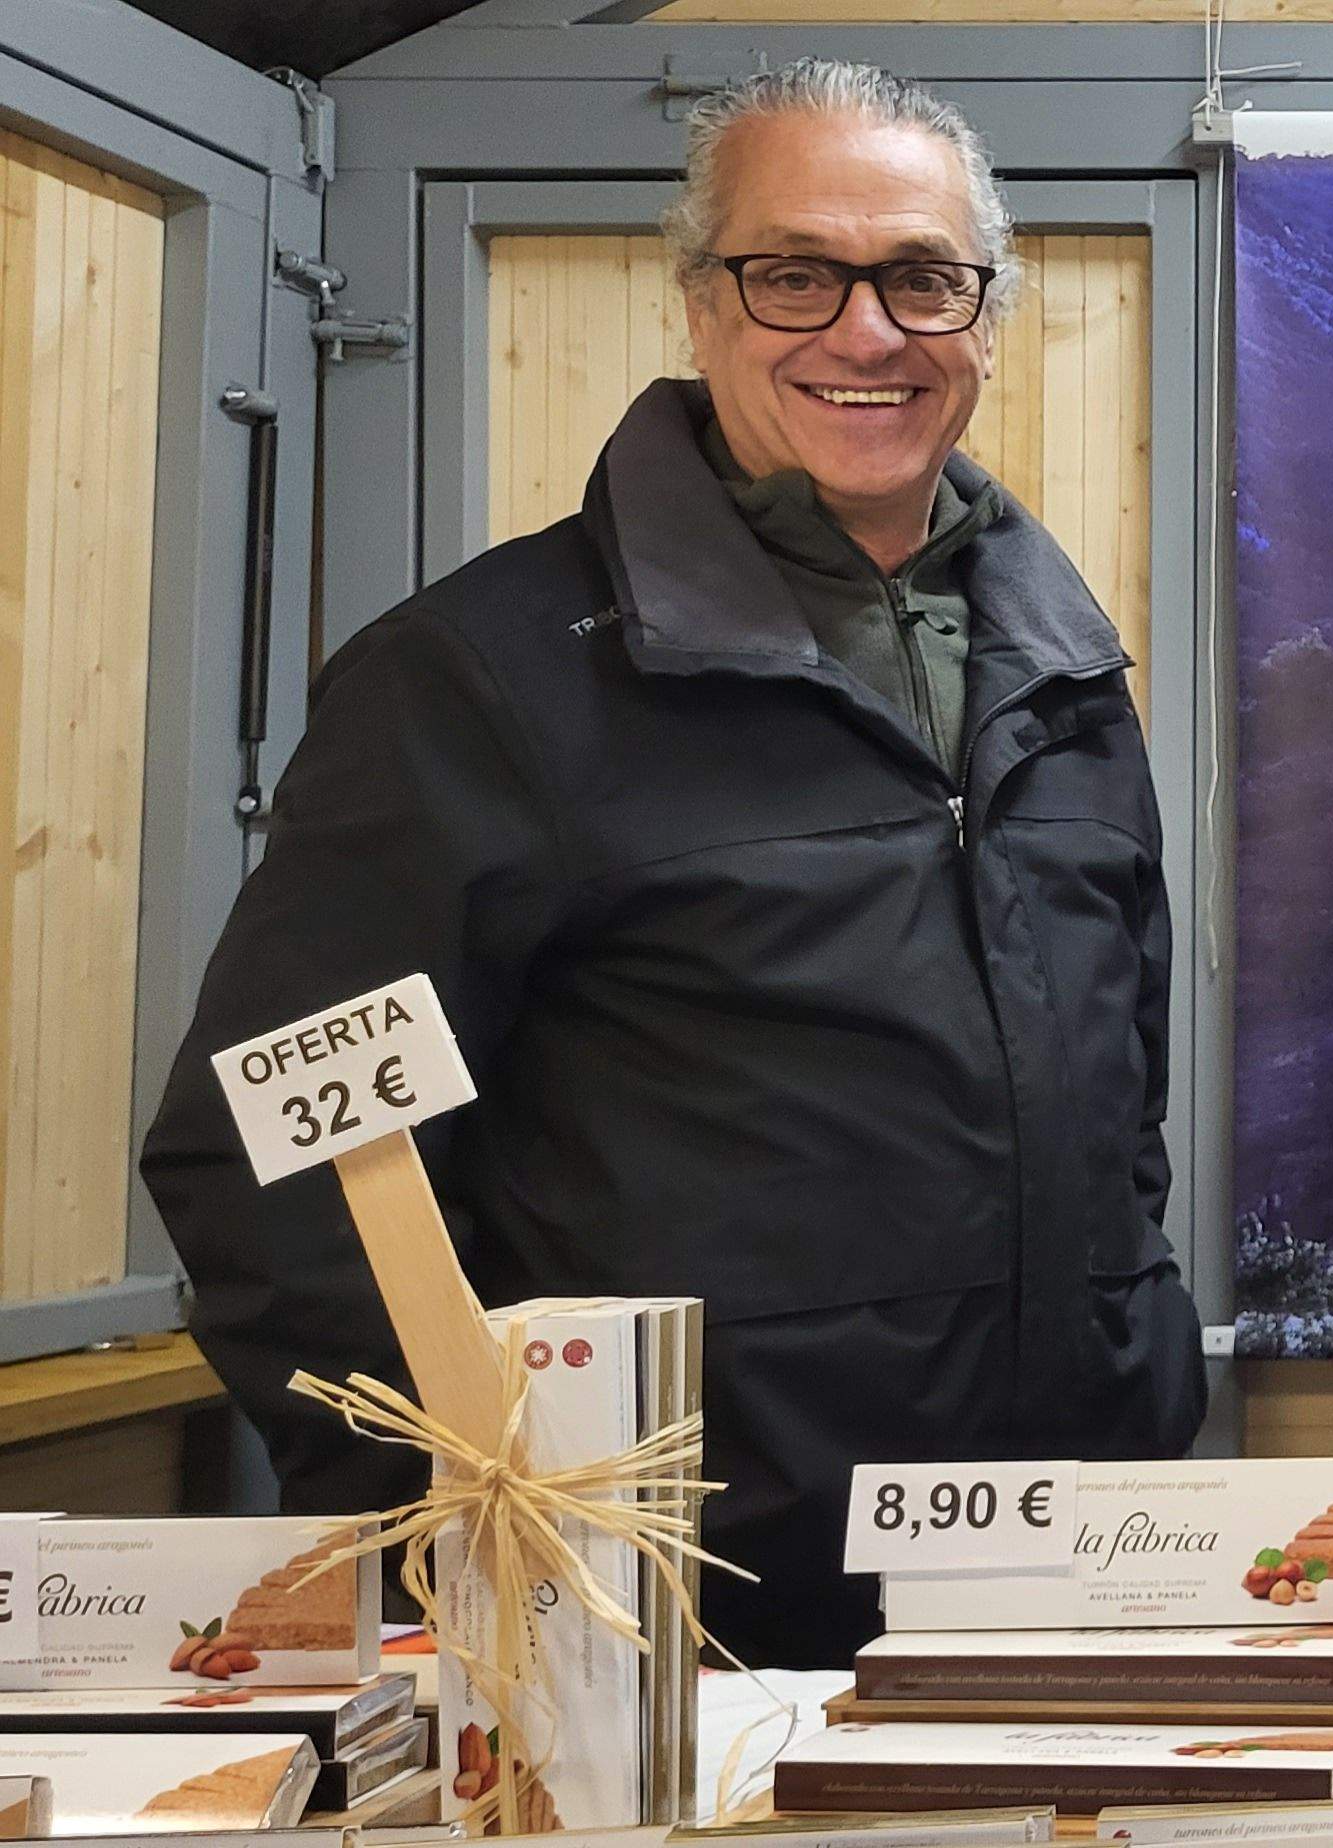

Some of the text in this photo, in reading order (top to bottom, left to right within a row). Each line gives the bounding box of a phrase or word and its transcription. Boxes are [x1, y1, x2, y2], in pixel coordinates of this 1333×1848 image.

[241, 996, 415, 1085] OFERTA
[281, 1054, 418, 1147] 32 €
[873, 1479, 1055, 1540] 8,90 €
[1072, 1522, 1105, 1555] la
[1089, 1592, 1143, 1602] AVELLANA
[1158, 1591, 1198, 1601] PANELA
[1174, 1827, 1224, 1839] turrones
[1225, 1821, 1244, 1836] del
